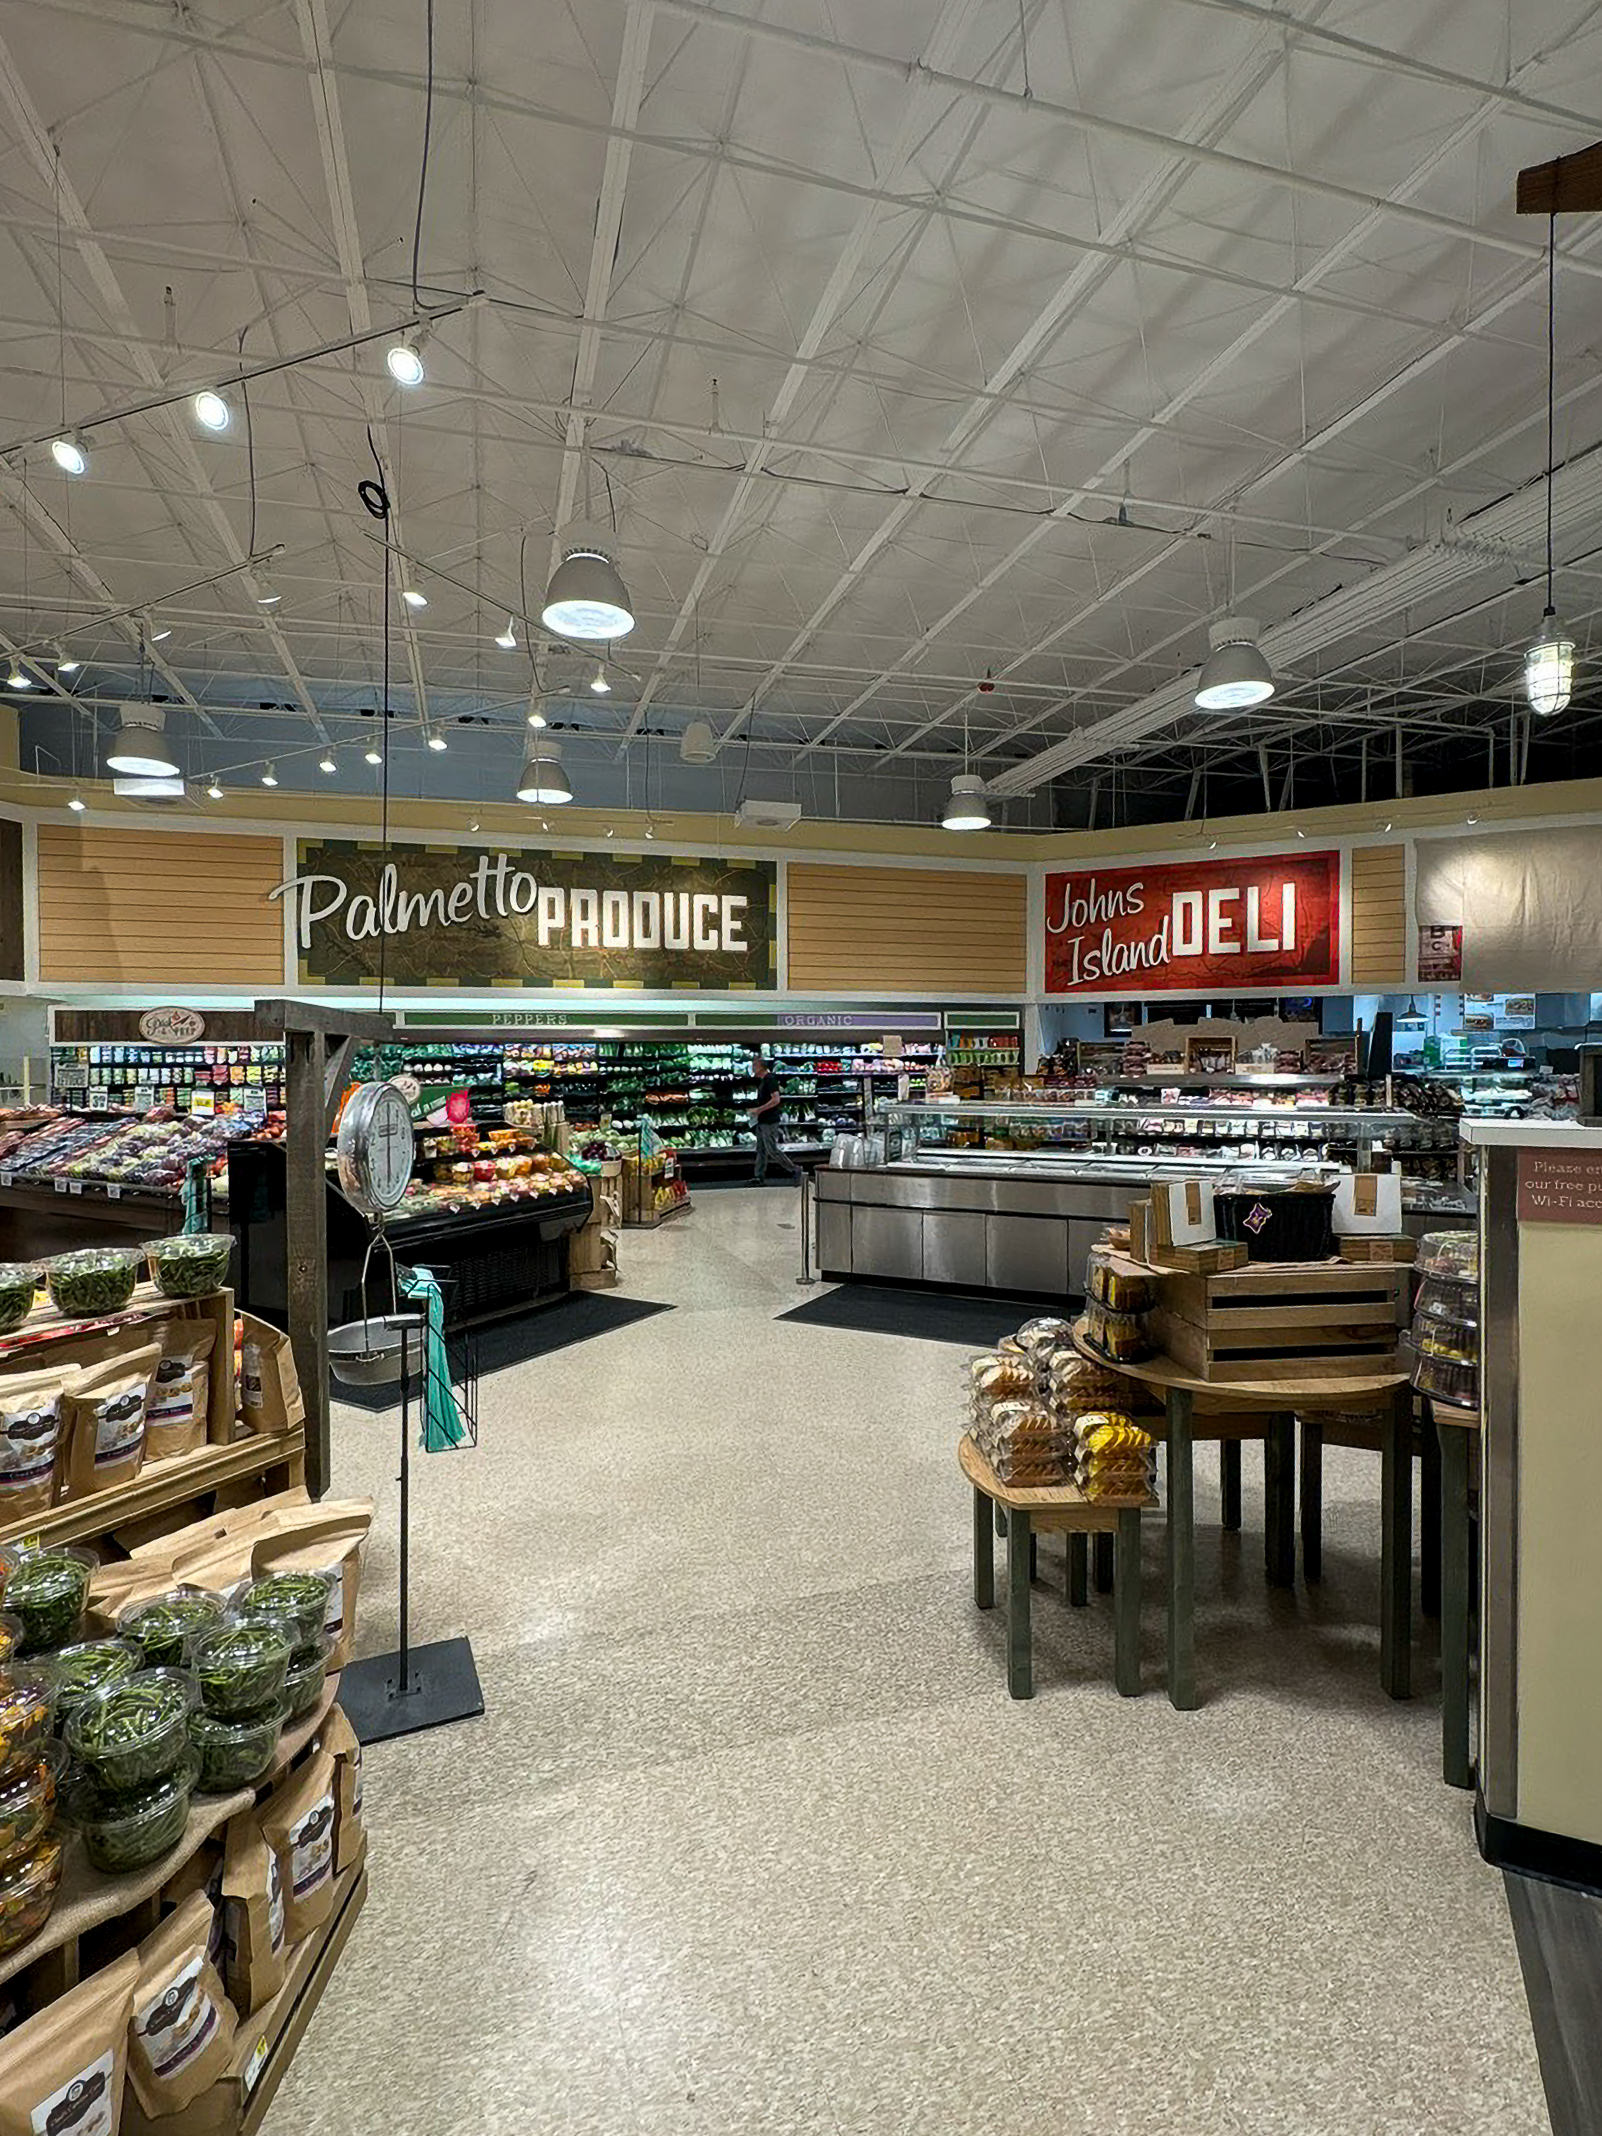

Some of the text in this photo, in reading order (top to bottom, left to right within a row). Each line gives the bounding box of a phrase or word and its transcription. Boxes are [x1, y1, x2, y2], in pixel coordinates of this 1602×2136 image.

[268, 853, 748, 952] Palmetto PRODUCE
[1046, 878, 1145, 934] Johns
[1172, 882, 1296, 957] DELI
[1067, 915, 1171, 986] Island
[492, 1014, 568, 1025] PEPPERS
[784, 1015, 853, 1026] ORGANIC
[1534, 1161, 1581, 1174] Please
[1525, 1180, 1551, 1190] our
[1554, 1179, 1583, 1191] free
[1532, 1193, 1573, 1208] Wi-Fi
